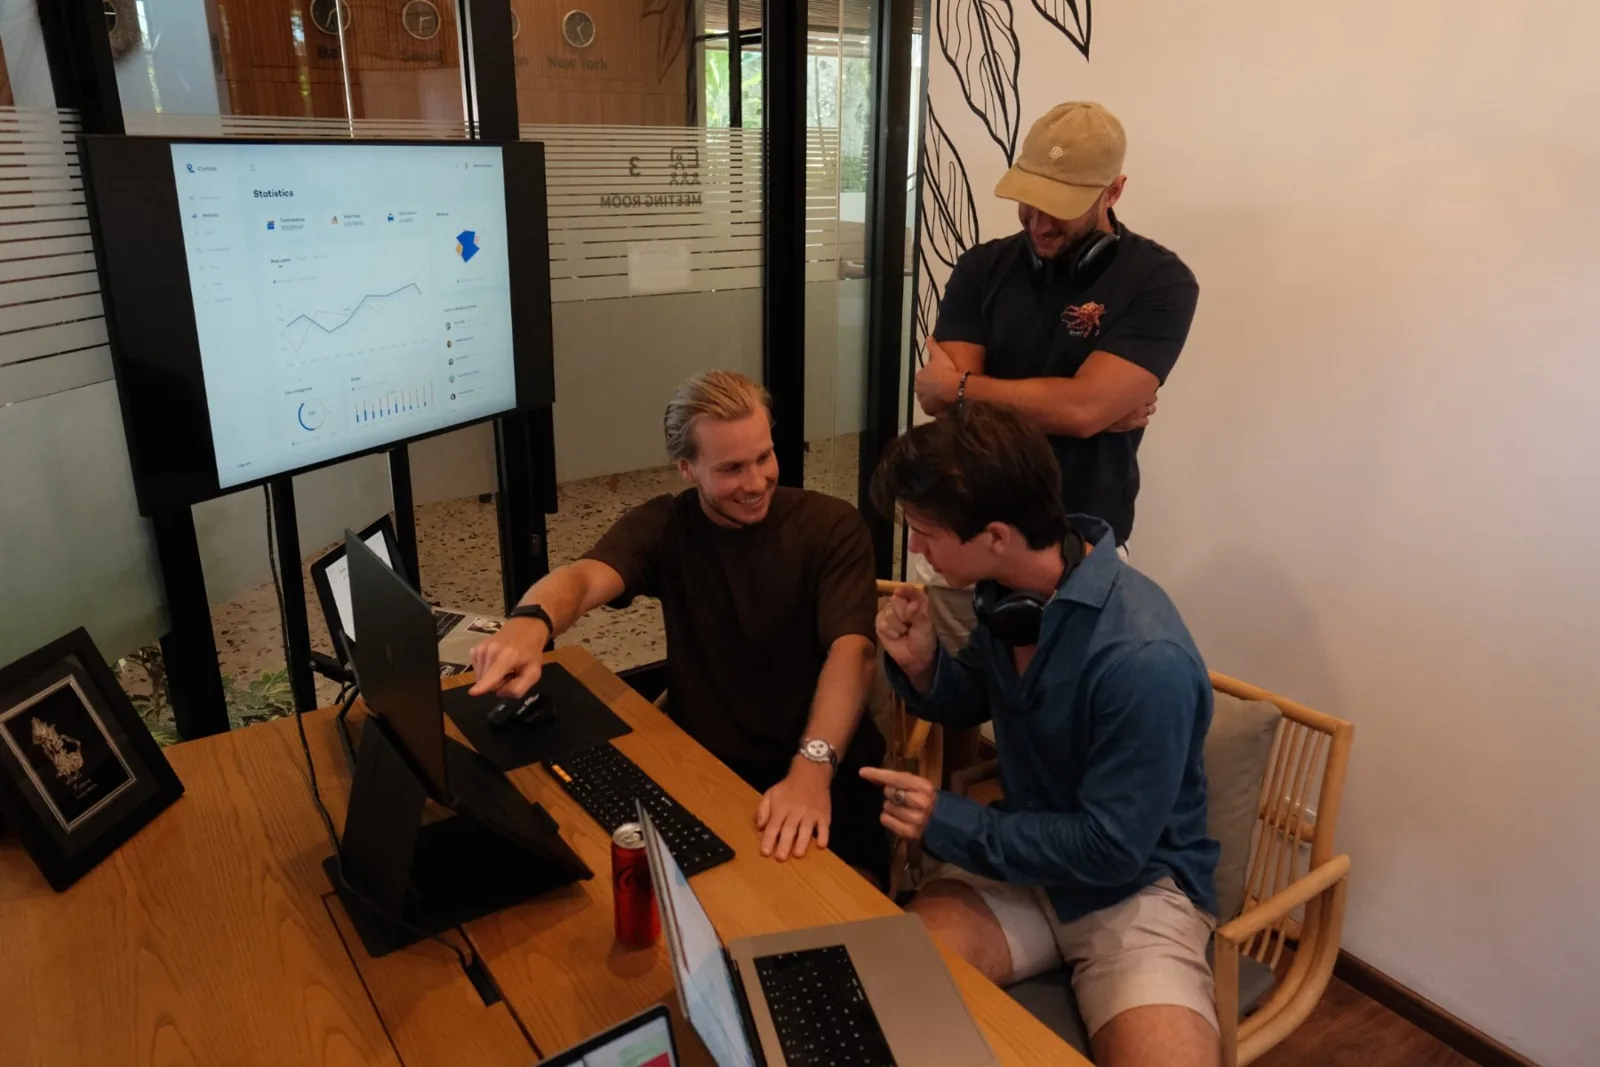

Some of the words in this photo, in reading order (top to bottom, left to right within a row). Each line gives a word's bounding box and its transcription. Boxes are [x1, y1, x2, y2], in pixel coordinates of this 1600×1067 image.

[547, 55, 576, 69] New
[580, 56, 608, 70] York
[253, 188, 294, 199] Statistics
